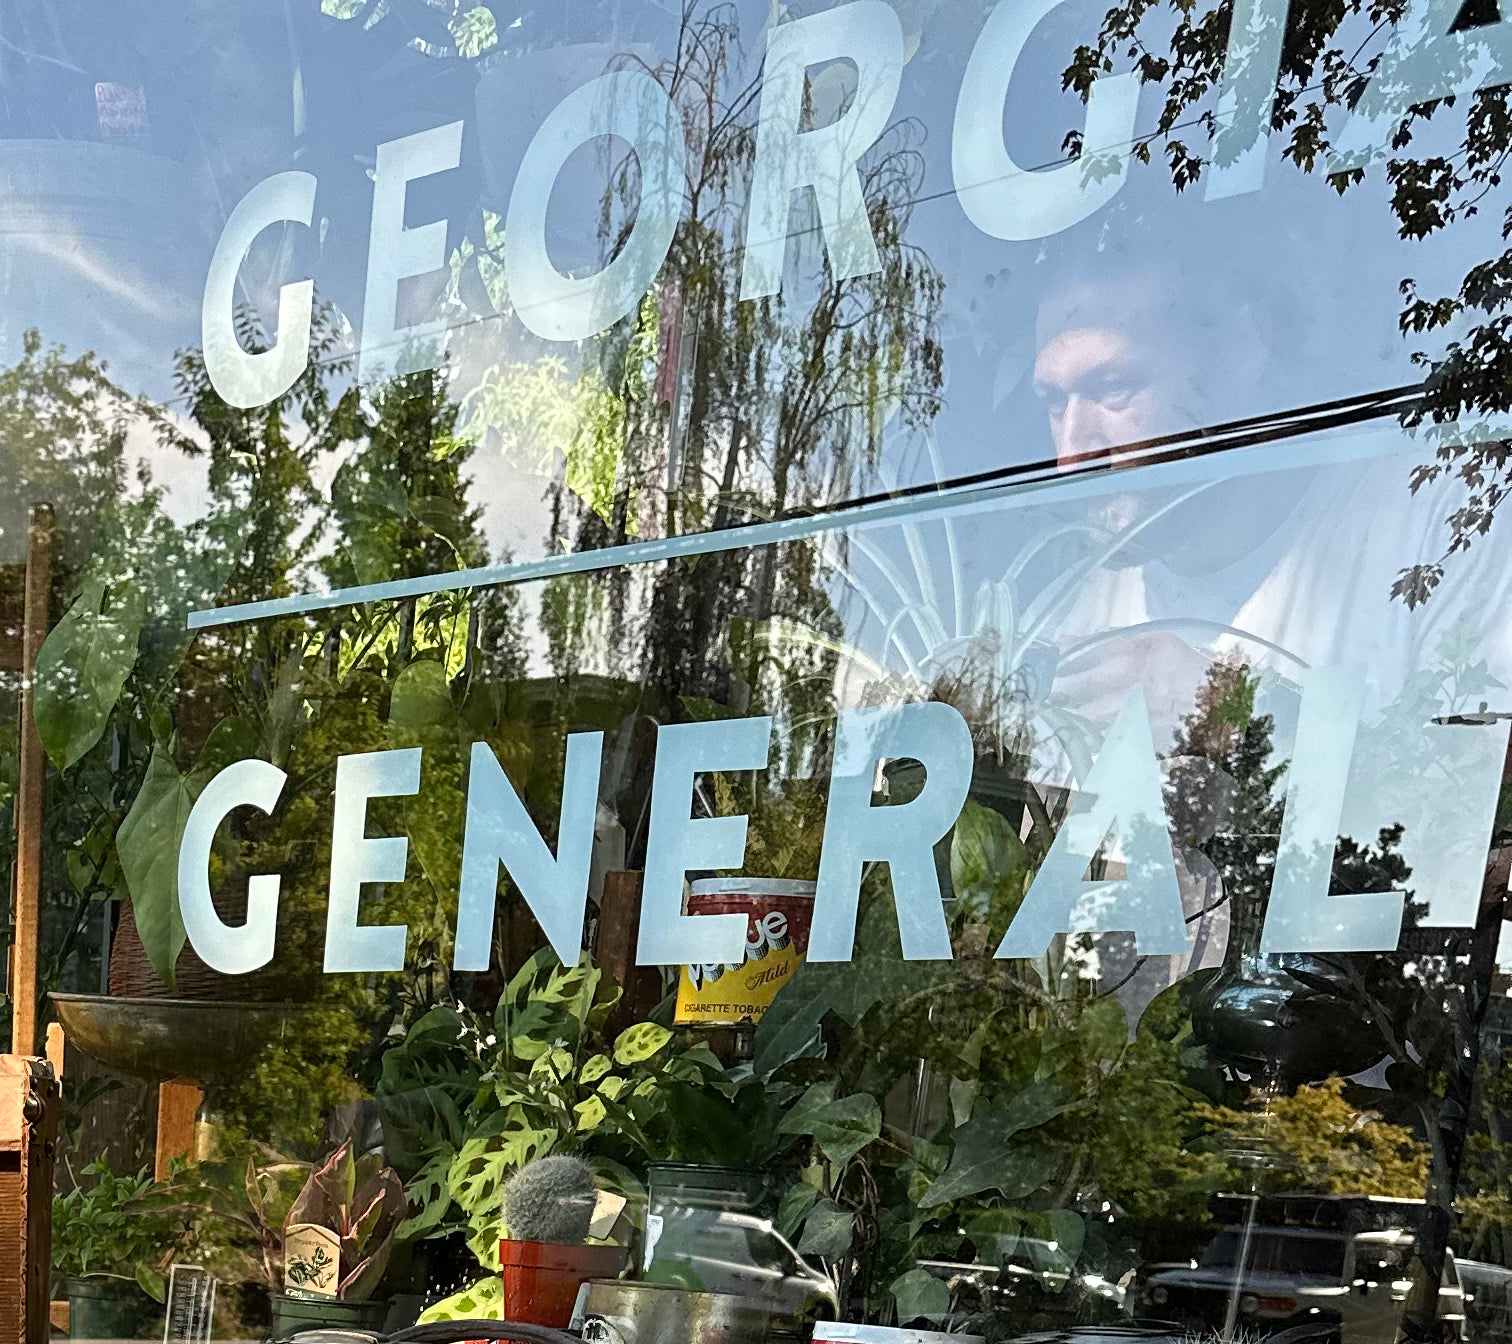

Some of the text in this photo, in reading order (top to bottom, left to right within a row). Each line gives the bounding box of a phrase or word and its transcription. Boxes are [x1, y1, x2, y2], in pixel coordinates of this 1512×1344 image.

[178, 662, 1406, 975] GENERAL
[745, 962, 788, 991] Mild
[732, 1004, 769, 1015] TOBAC
